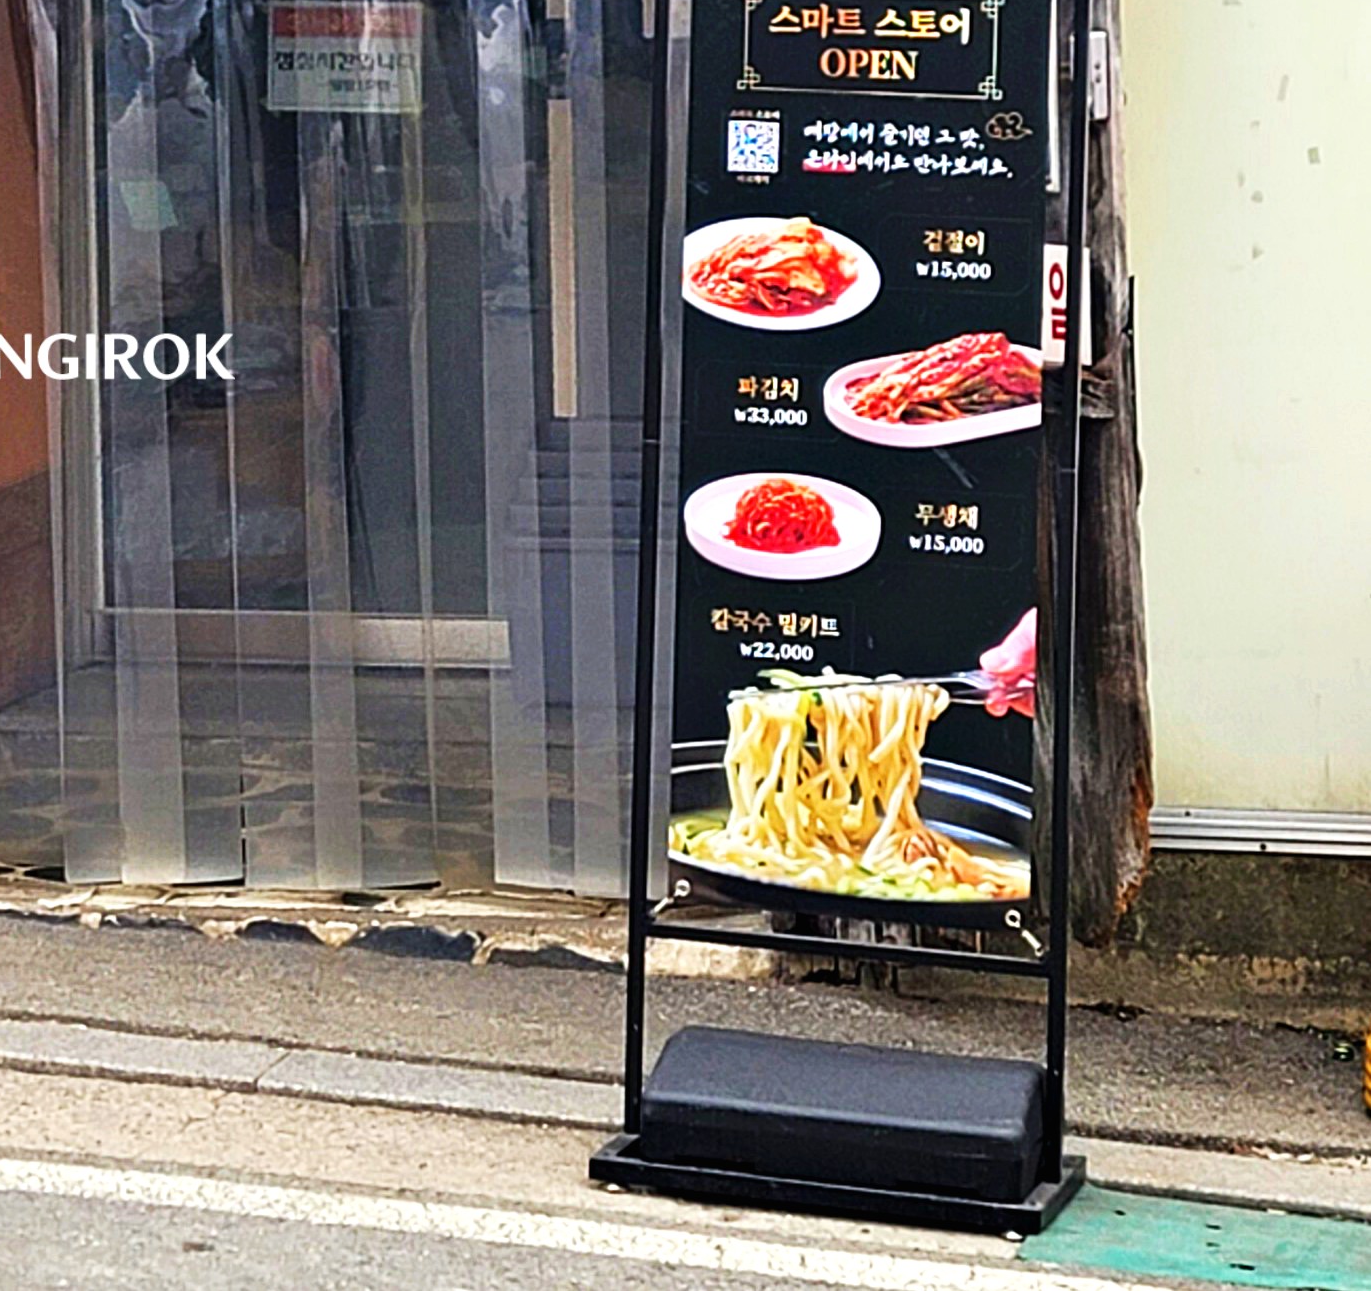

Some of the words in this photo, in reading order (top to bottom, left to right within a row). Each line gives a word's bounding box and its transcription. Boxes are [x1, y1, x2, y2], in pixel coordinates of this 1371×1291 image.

[768, 3, 867, 39] 스마트
[873, 7, 971, 45] 스토어
[819, 47, 919, 81] OPEN
[737, 375, 799, 402] 파김치
[915, 503, 979, 531] 무생채
[711, 607, 772, 633] 칼국수
[778, 612, 840, 638] 밀키트
